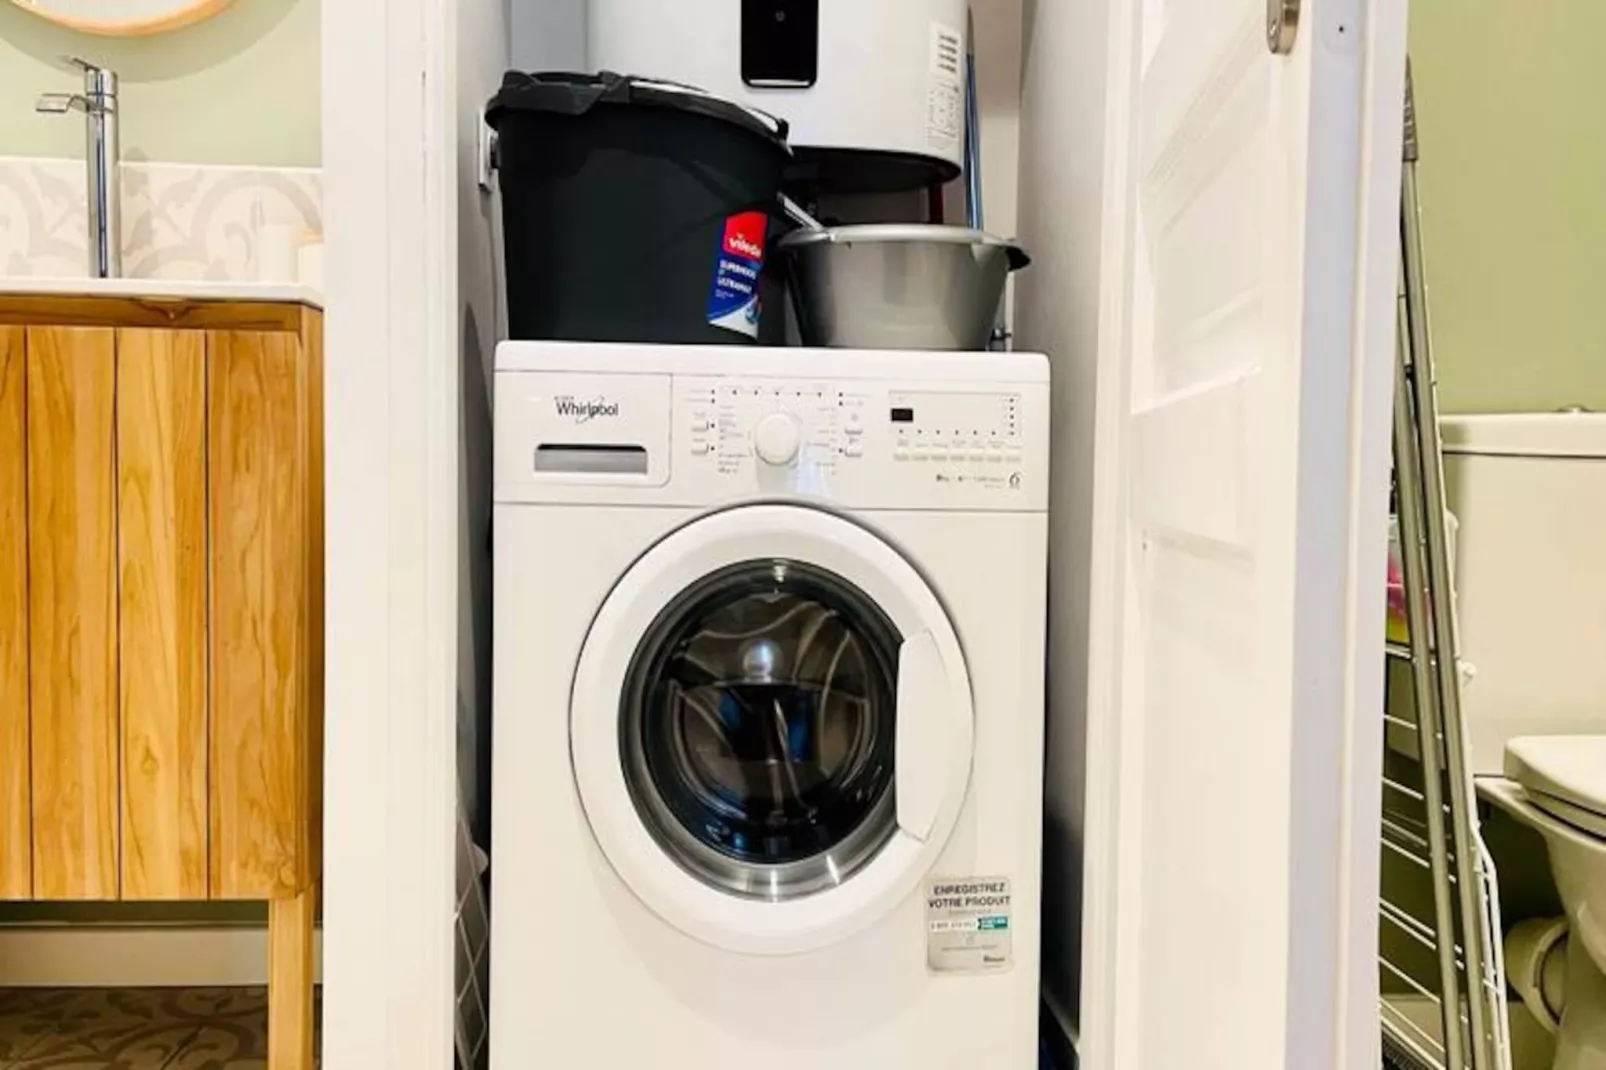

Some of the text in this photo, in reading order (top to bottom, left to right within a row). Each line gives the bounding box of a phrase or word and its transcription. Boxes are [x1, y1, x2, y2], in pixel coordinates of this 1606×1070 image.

[555, 402, 618, 418] Whirlpool
[934, 883, 1005, 895] ENREGISTREZ
[929, 896, 1010, 908] VOTRE PRODUIT
